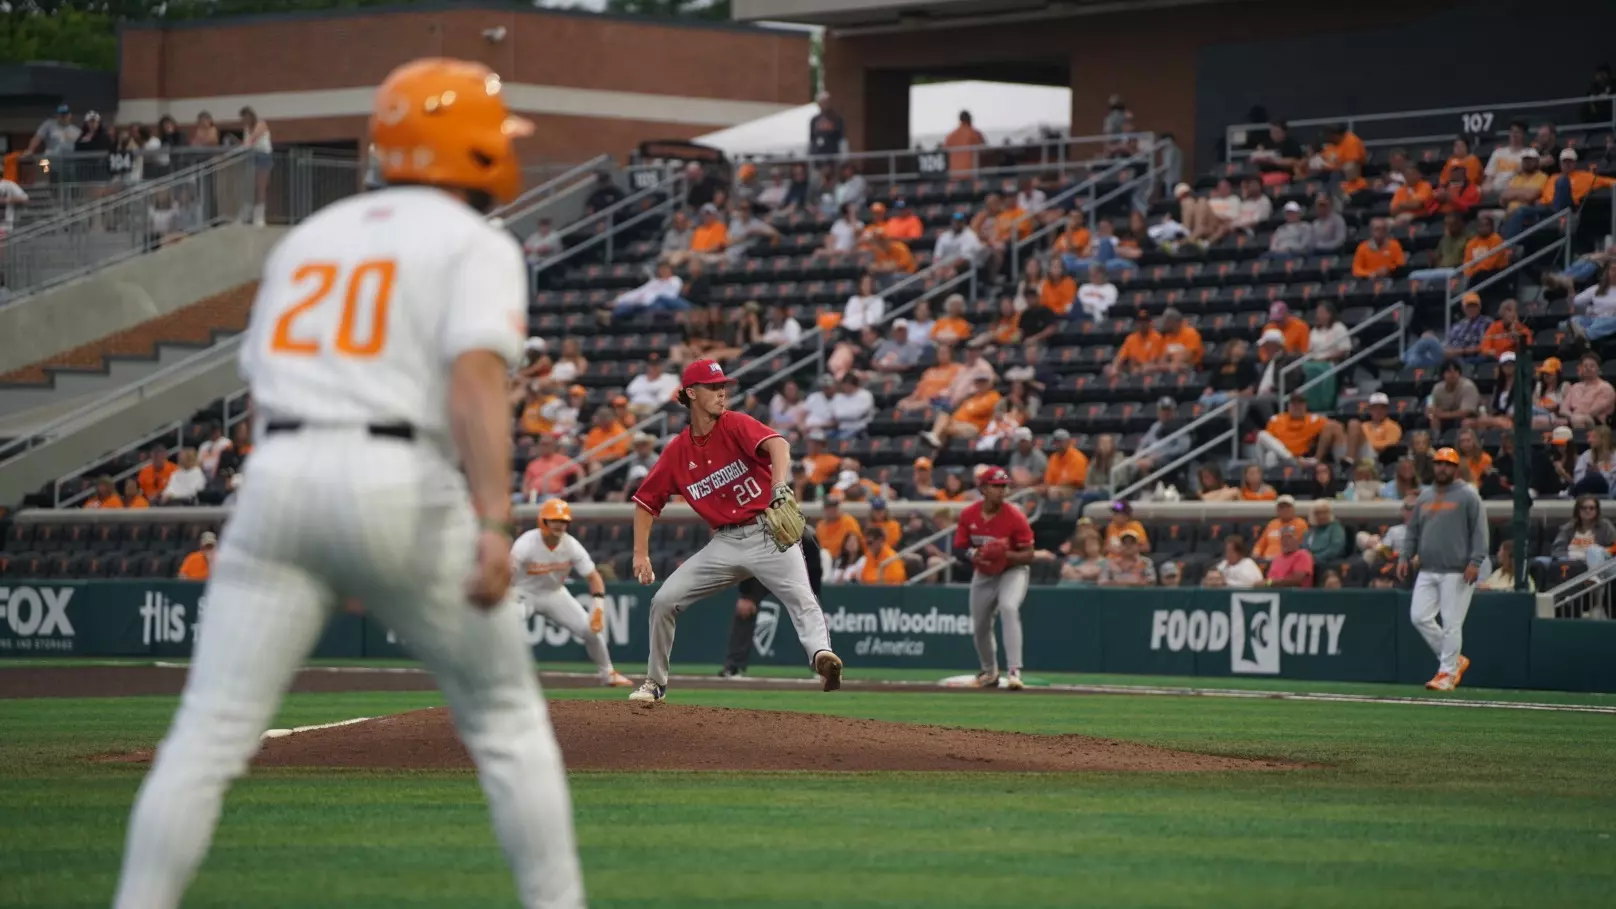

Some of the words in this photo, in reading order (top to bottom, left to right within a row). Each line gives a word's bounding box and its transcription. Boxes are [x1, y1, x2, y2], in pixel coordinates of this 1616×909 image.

[1461, 112, 1494, 133] 107
[110, 152, 131, 171] 104
[270, 258, 397, 358] 20
[710, 458, 749, 490] GEORGIA
[733, 476, 762, 507] 20
[824, 606, 877, 632] odern
[1150, 609, 1230, 652] FOOD
[1280, 612, 1346, 656] CITY
[855, 635, 872, 655] of
[872, 637, 924, 656] America
